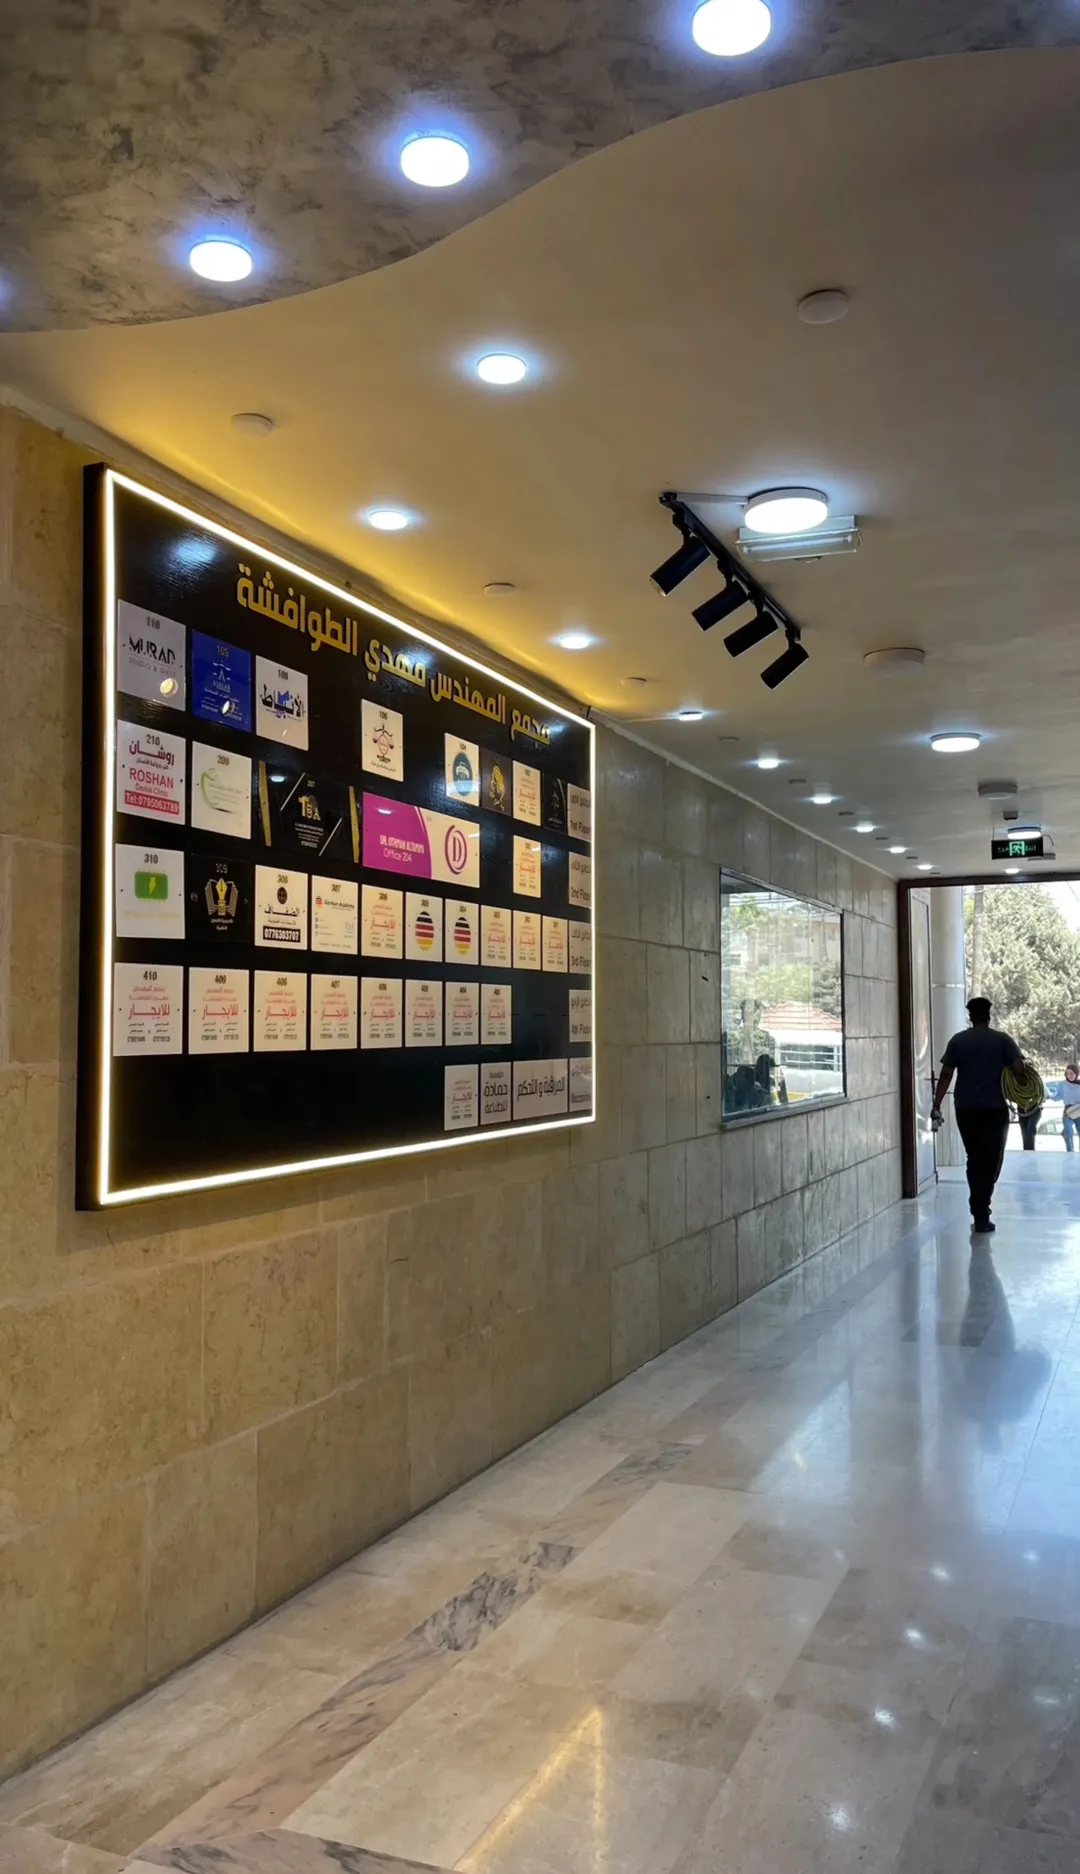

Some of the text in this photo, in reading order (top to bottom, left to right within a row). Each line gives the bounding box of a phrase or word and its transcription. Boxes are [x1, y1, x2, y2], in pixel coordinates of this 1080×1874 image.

[146, 616, 160, 630] 110
[129, 634, 176, 665] MURAD
[237, 563, 551, 748] مجمع المهندس مهدي الطوافشة
[146, 734, 160, 746] 210
[129, 740, 175, 766] روشان
[129, 767, 174, 789] ROSHAN
[135, 783, 168, 797] Dental Clinic
[144, 853, 158, 864] 310
[383, 848, 412, 862] Office 204
[264, 928, 299, 941] 0776303707
[143, 971, 157, 980] 410
[215, 975, 226, 984] 409
[483, 1081, 508, 1097] حمادة
